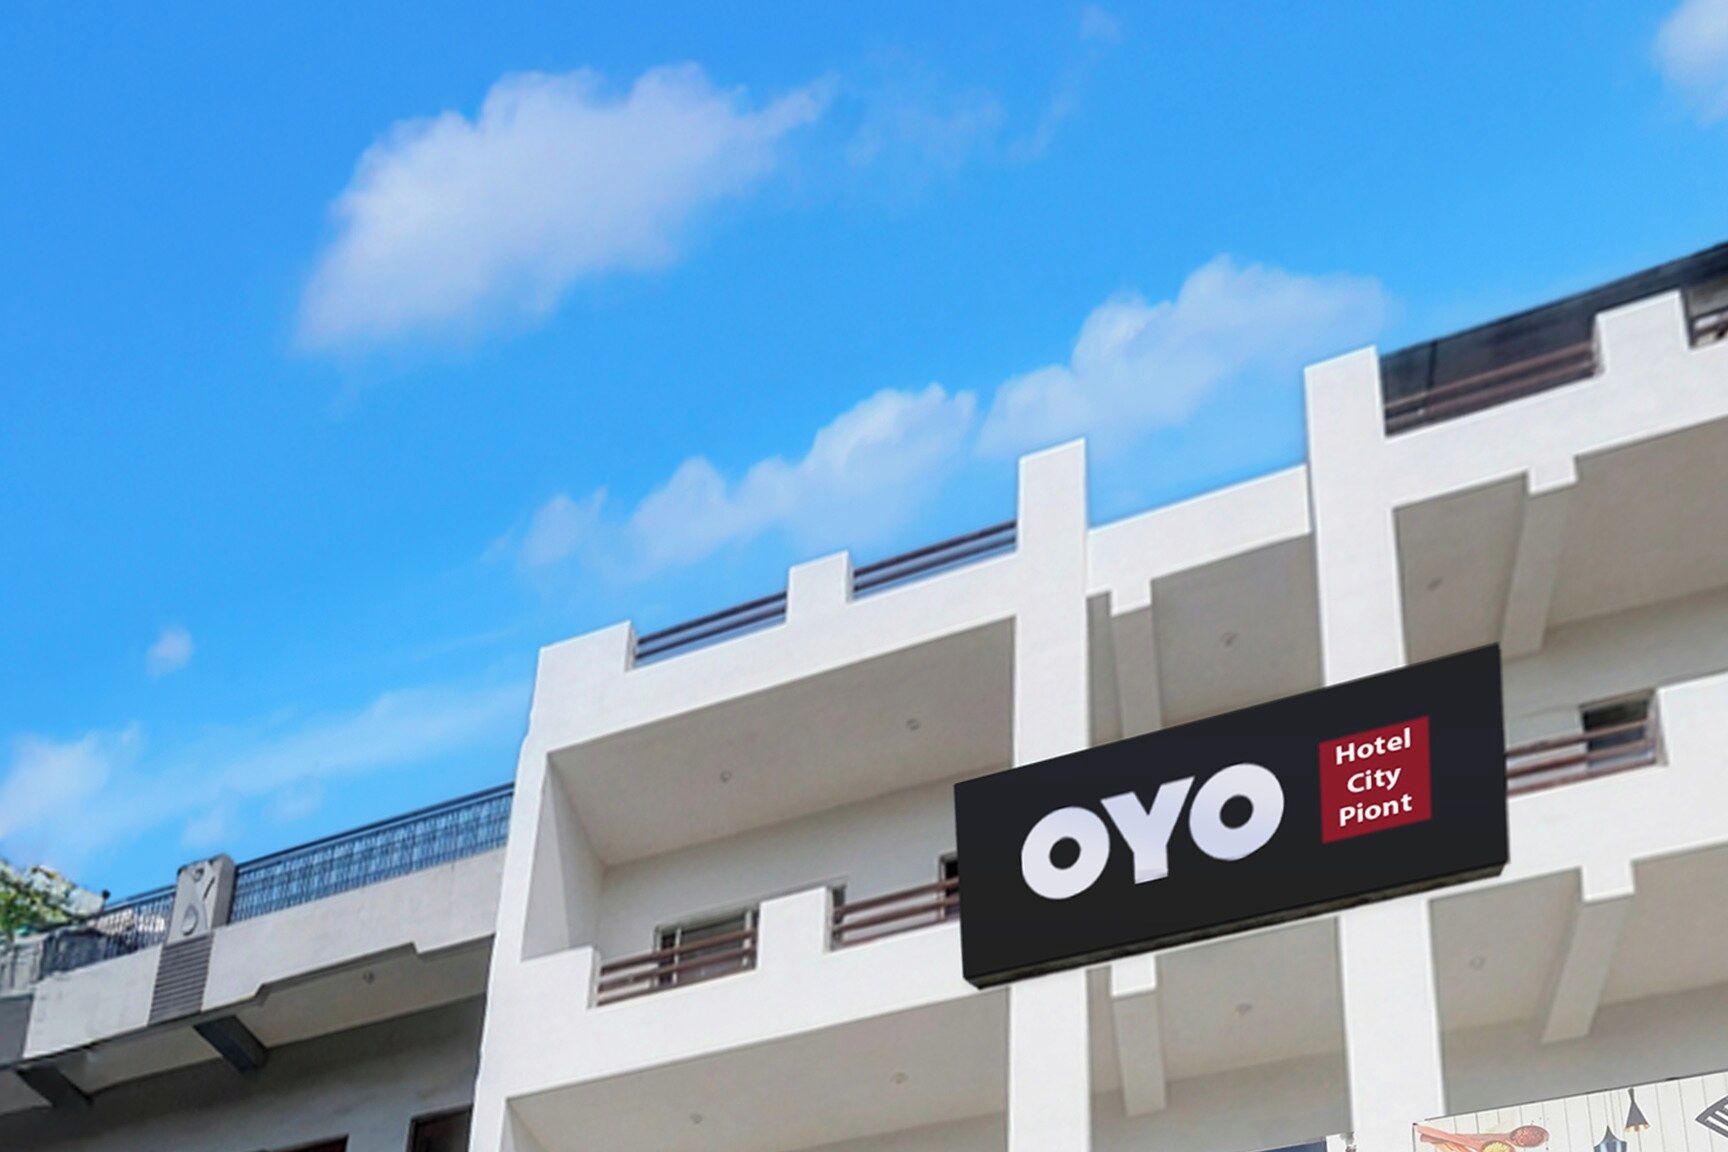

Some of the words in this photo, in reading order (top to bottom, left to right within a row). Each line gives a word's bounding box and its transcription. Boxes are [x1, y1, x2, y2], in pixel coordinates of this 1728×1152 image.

[1335, 727, 1411, 765] Hotel
[1346, 767, 1402, 794] City
[1338, 793, 1412, 827] Piont
[1021, 763, 1285, 900] OYO
